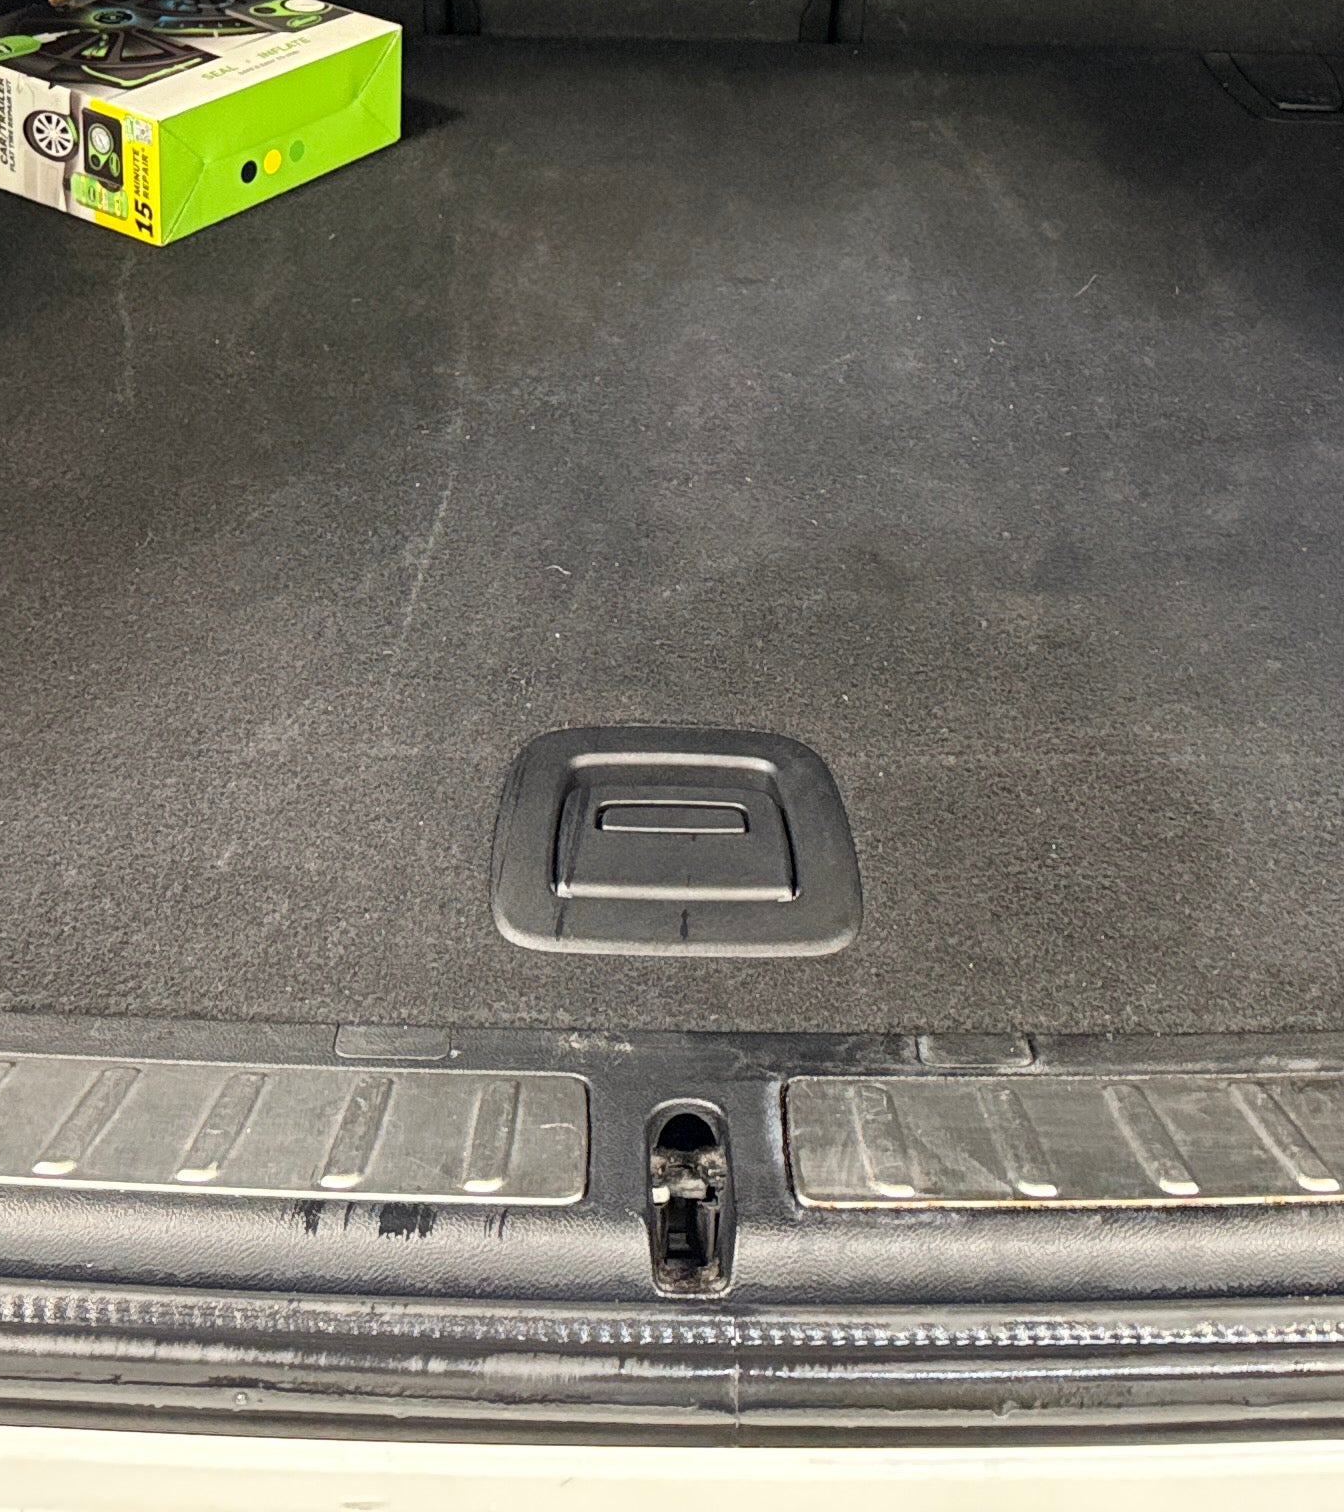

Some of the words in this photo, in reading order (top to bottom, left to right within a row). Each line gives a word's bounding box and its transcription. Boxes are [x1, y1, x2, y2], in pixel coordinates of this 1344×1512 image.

[201, 65, 238, 80] SEAL
[257, 37, 311, 58] INFLATE
[132, 147, 140, 196] MINUTE
[134, 199, 153, 237] 15
